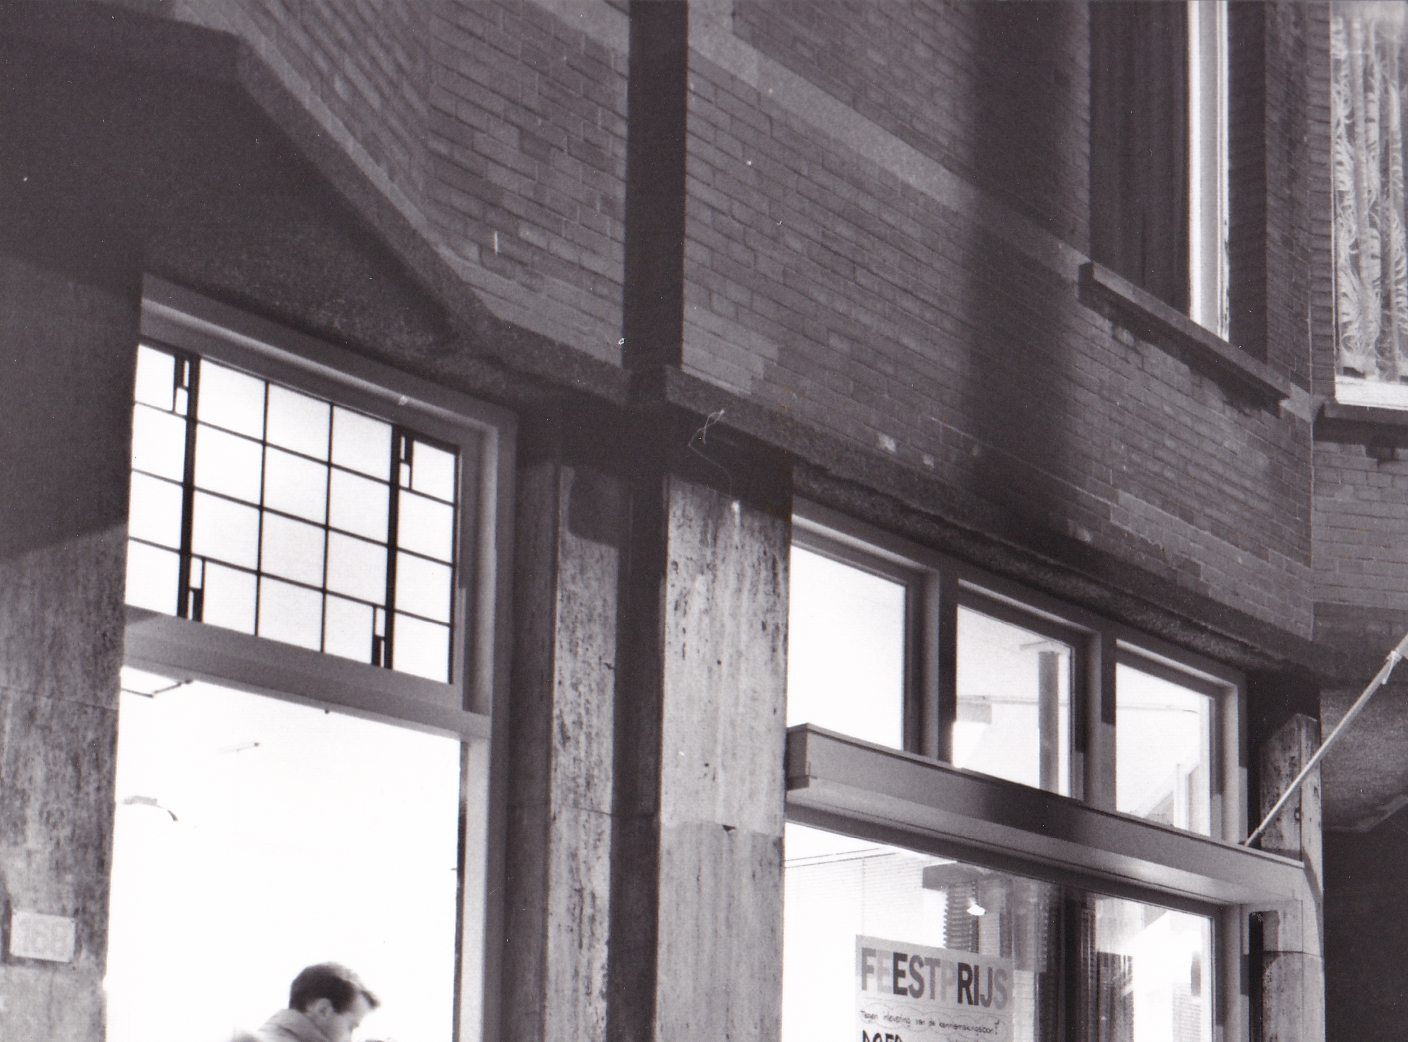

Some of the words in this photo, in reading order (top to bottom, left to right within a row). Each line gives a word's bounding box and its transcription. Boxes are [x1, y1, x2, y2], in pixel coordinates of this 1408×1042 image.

[860, 946, 1008, 1010] FEESTPRIJS
[860, 1010, 879, 1023] Tegen
[915, 1018, 926, 1026] van
[929, 1018, 936, 1027] de
